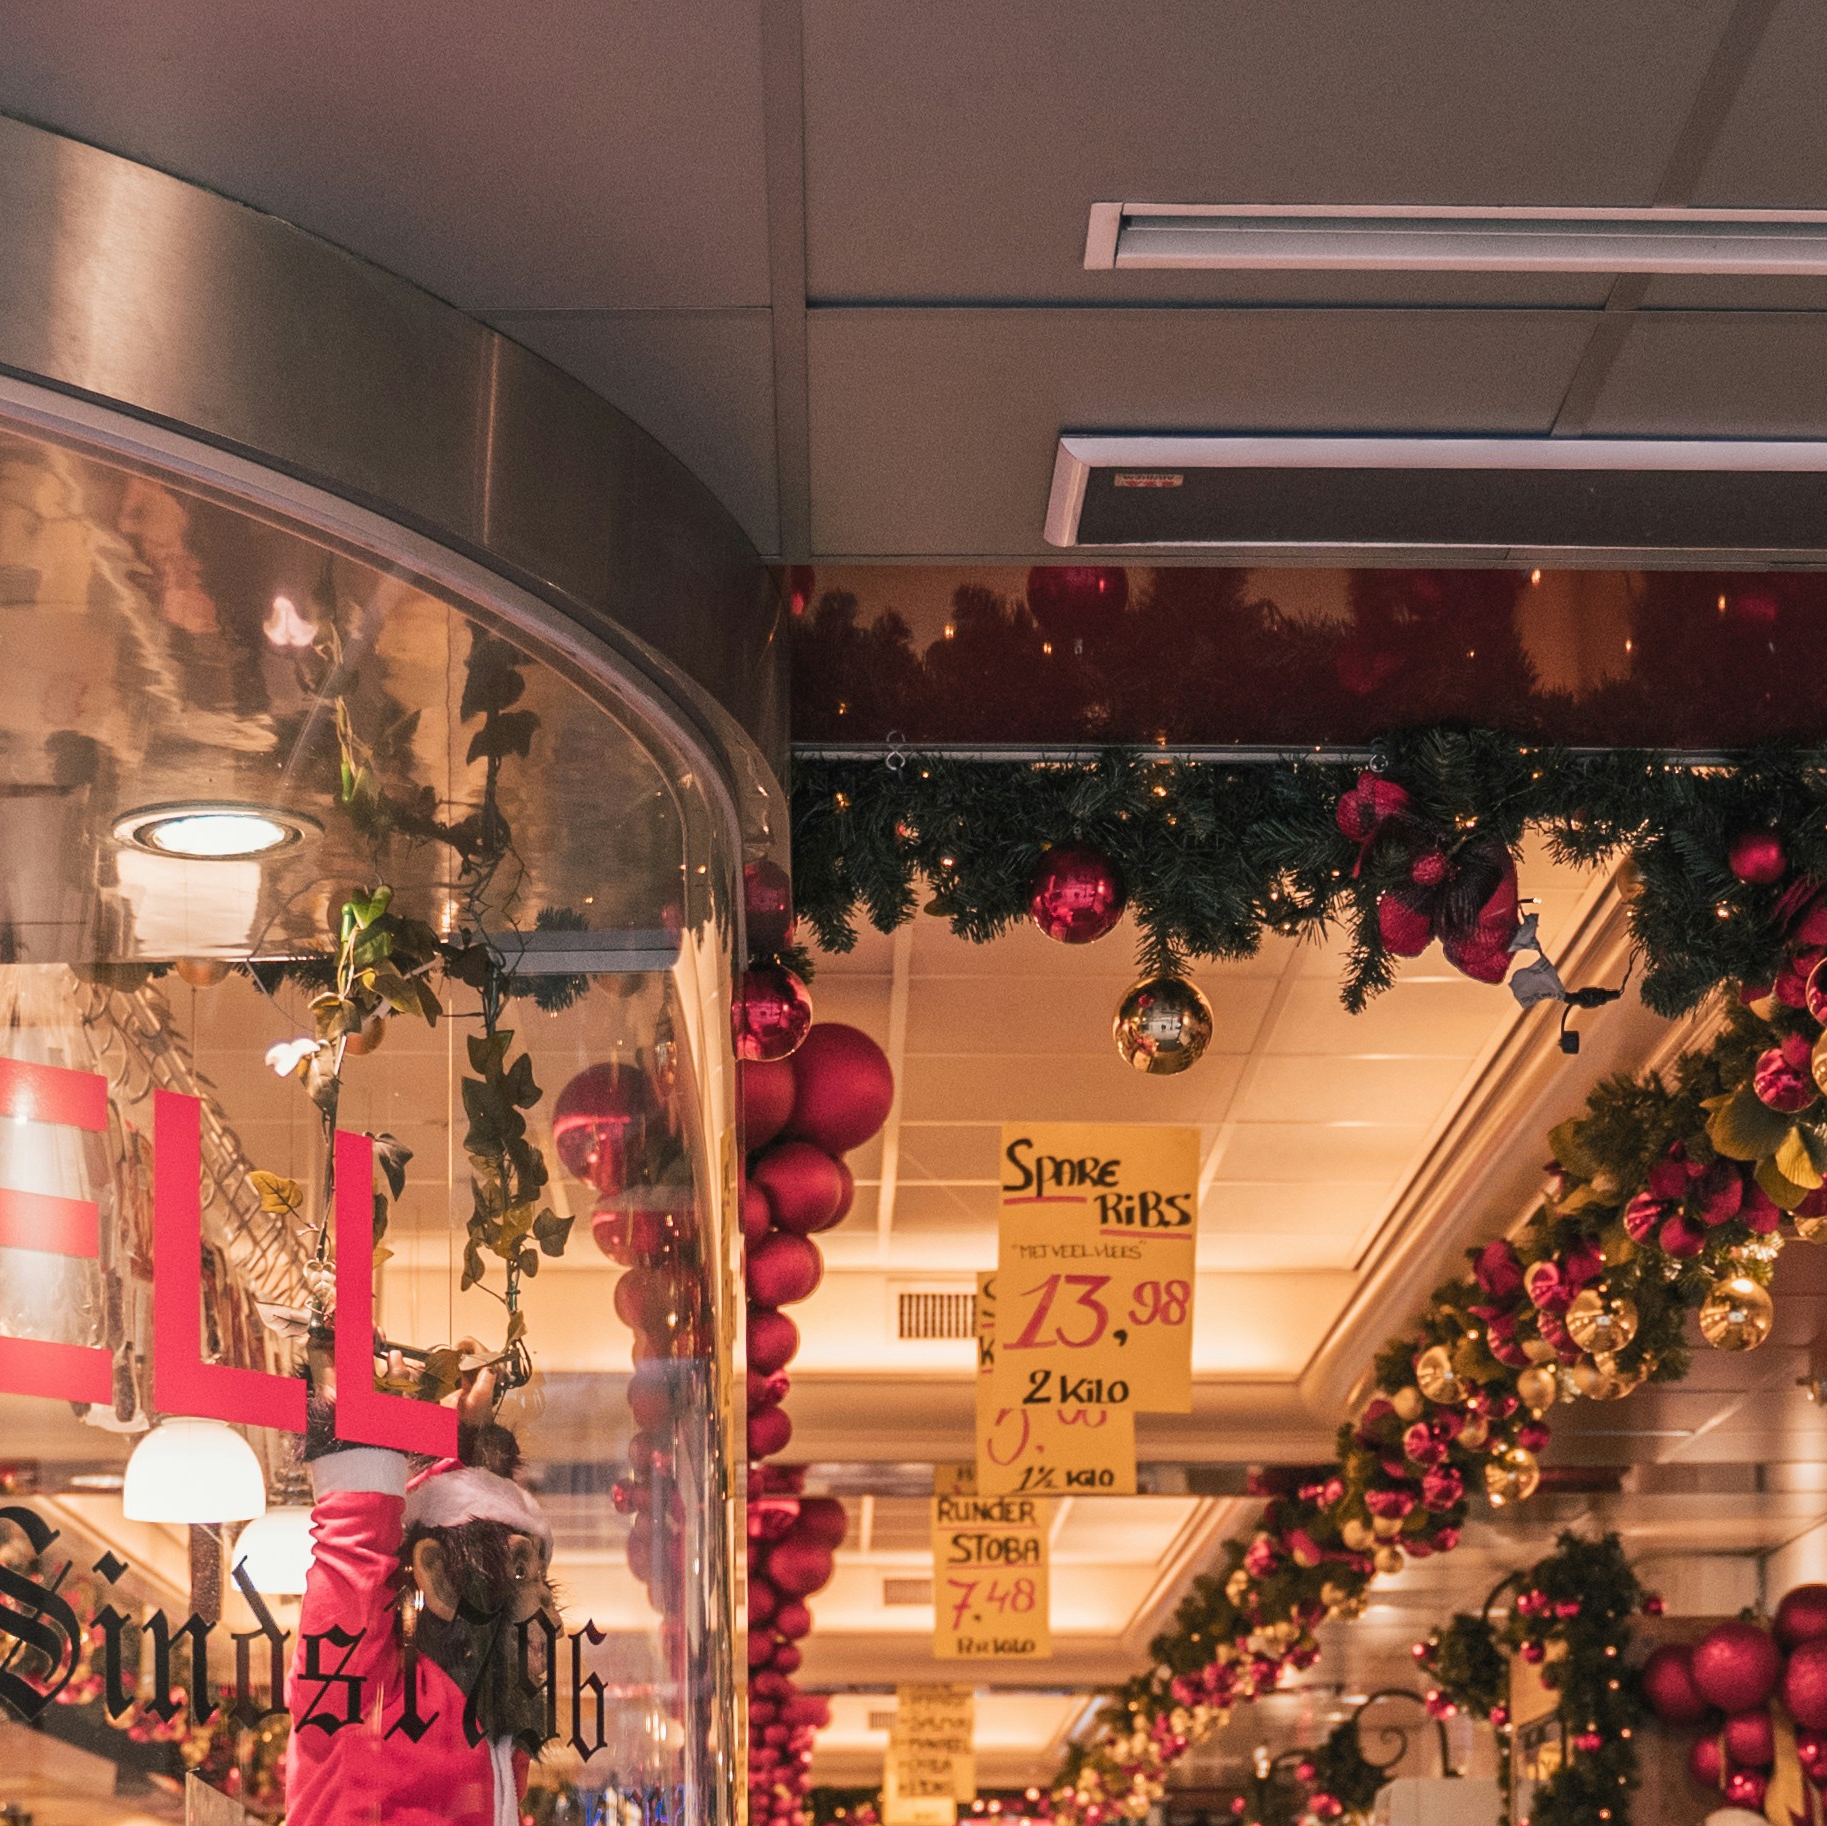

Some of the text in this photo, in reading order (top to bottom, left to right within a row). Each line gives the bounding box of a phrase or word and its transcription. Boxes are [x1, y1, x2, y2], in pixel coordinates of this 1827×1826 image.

[1003, 1273, 1191, 1350] 13,98
[1023, 1369, 1051, 1404] 2
[947, 1533, 1039, 1564] STOBA
[383, 1594, 609, 1762] 1796
